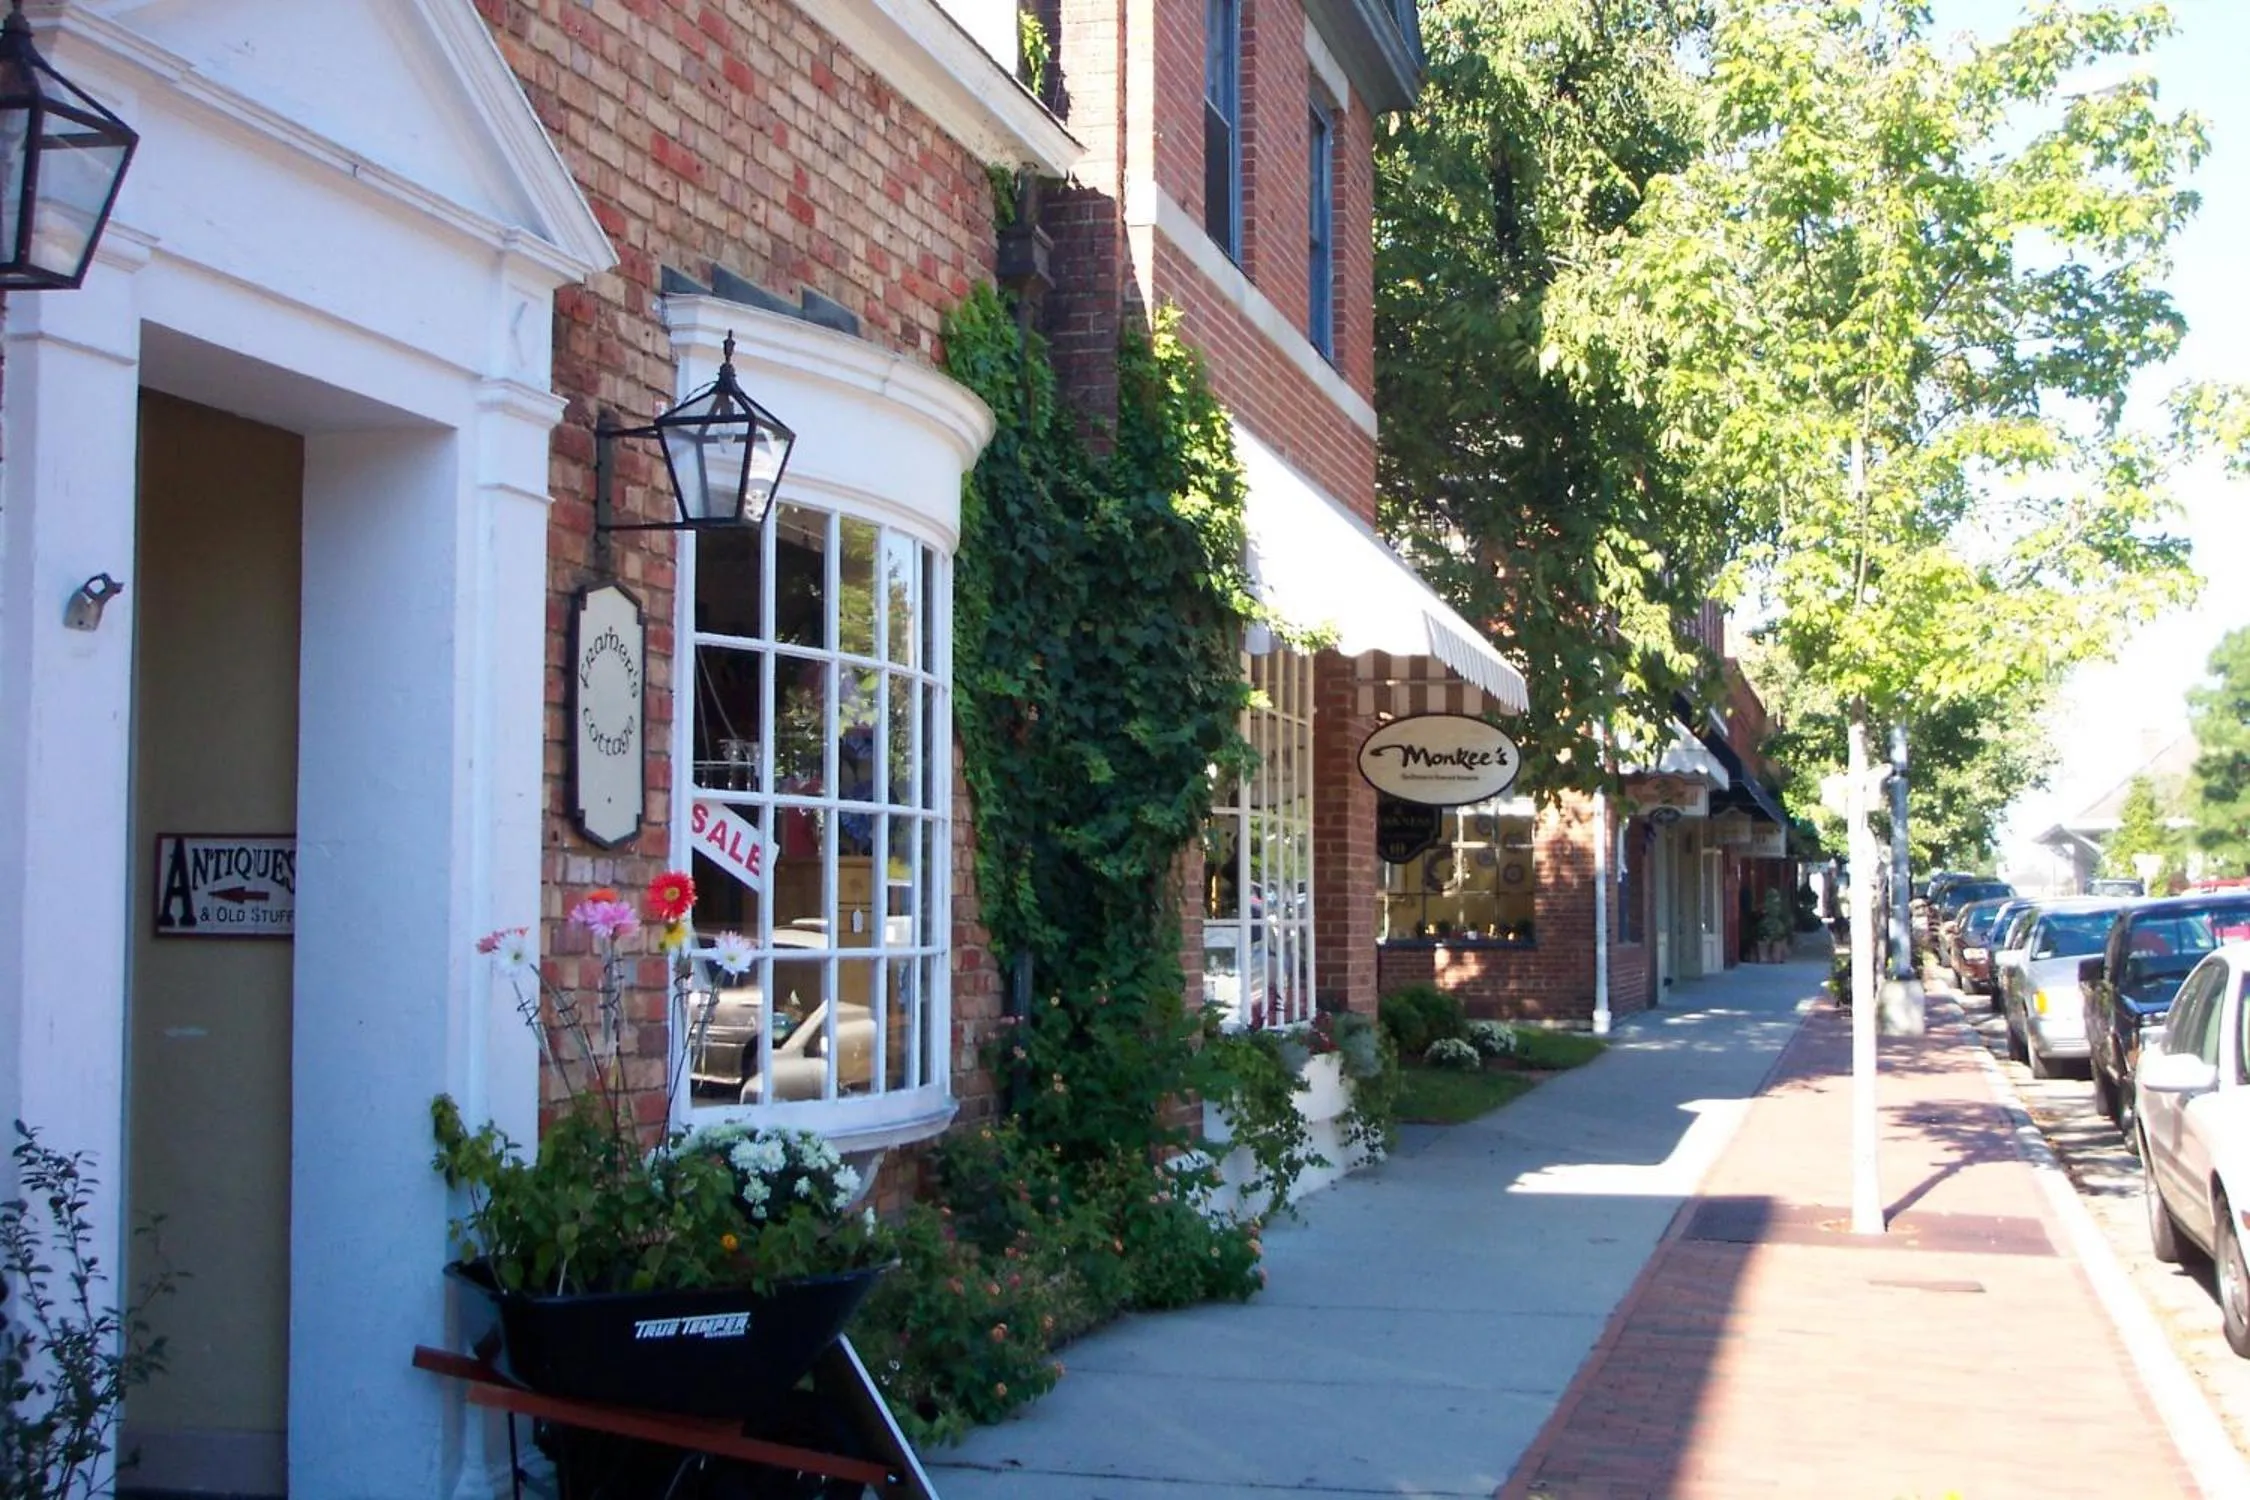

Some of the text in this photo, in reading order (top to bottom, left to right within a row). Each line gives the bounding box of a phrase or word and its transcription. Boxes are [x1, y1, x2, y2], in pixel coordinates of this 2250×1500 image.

[1370, 744, 1508, 770] Monkee's
[691, 803, 760, 876] SALE
[200, 909, 210, 922] &
[216, 908, 245, 922] OLD
[634, 1311, 750, 1339] TRUE TEMPER
